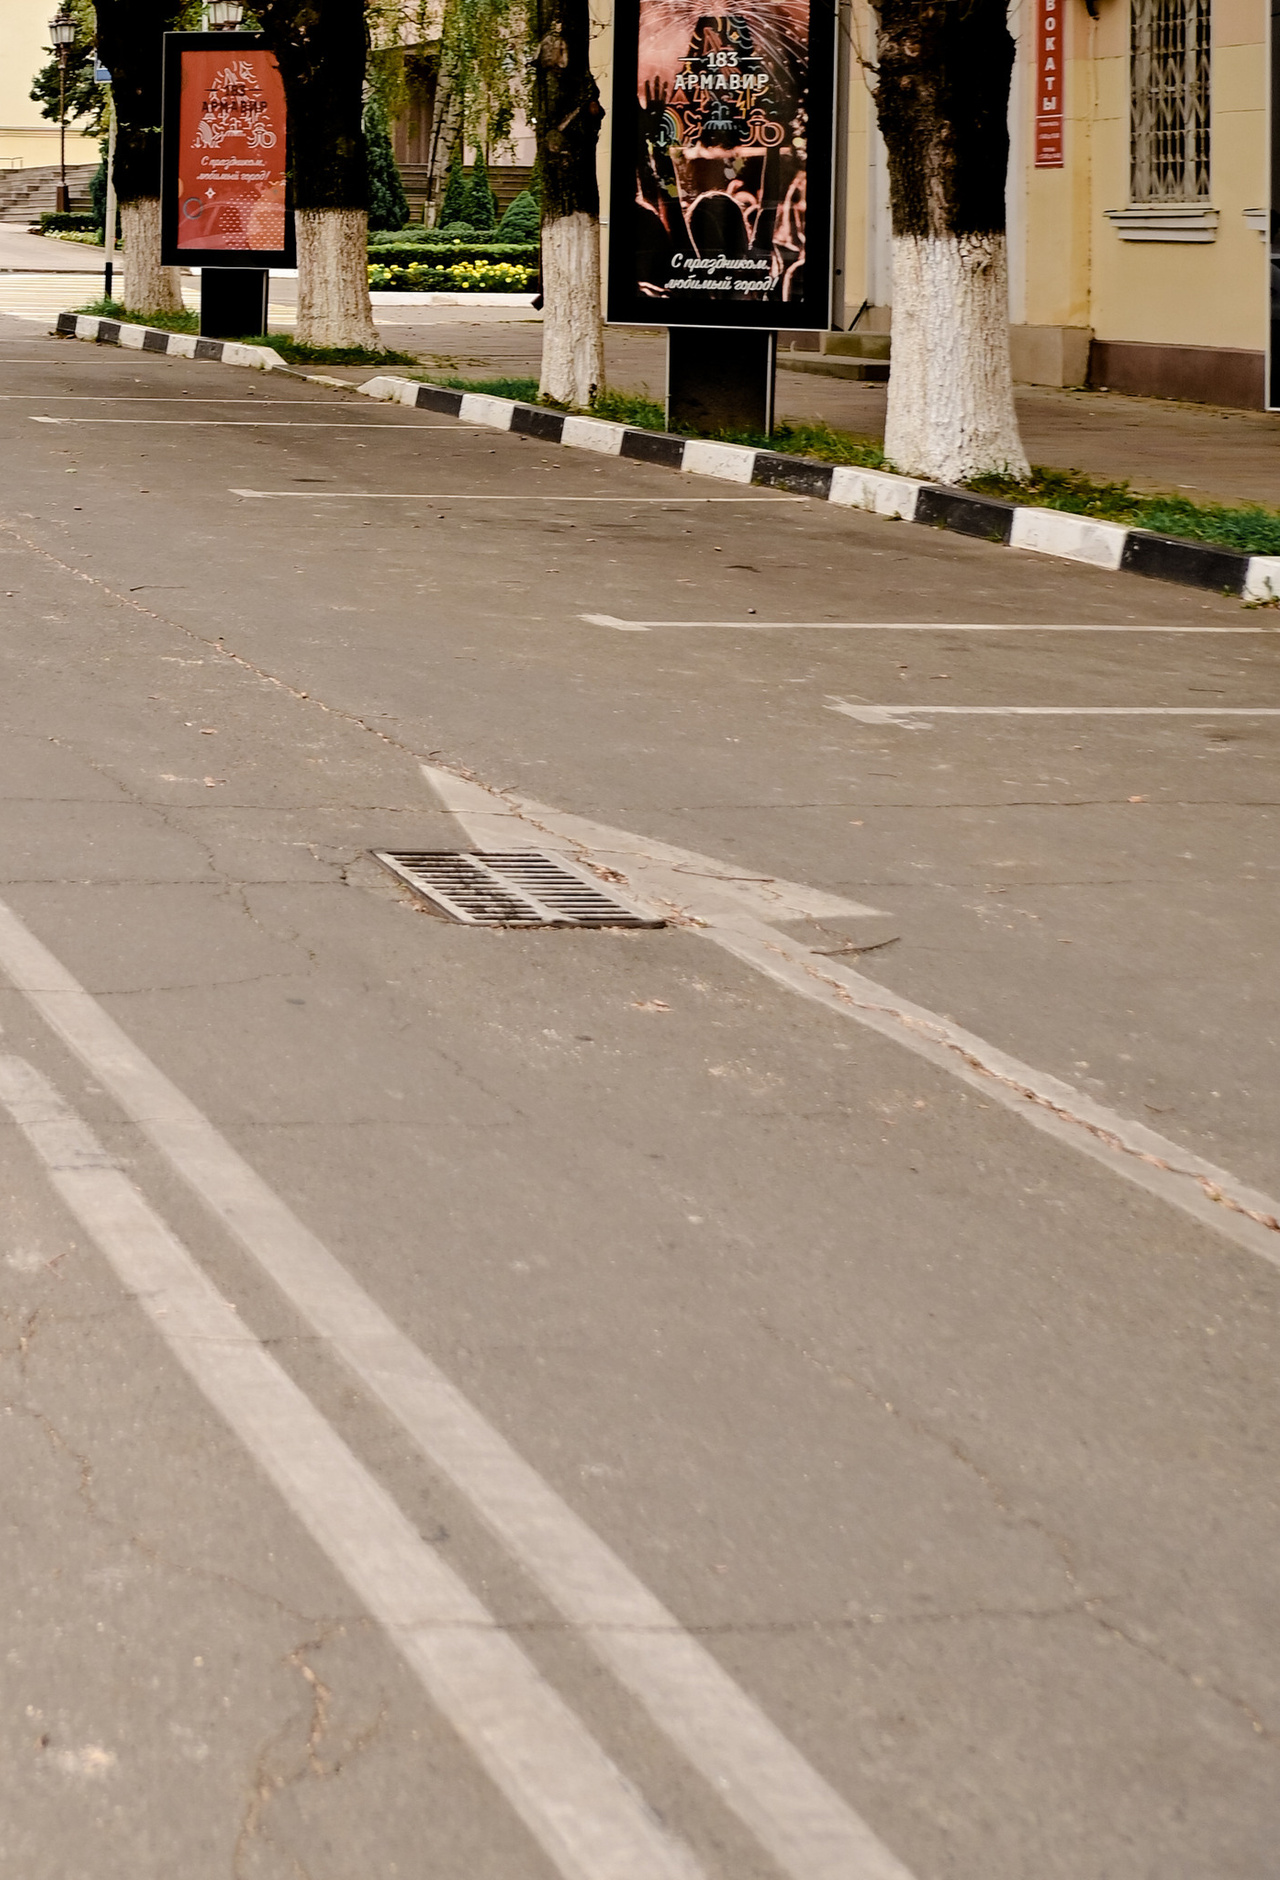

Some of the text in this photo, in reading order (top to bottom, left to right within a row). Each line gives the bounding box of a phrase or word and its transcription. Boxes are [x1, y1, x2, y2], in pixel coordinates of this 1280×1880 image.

[706, 51, 739, 68] 183
[673, 73, 770, 91] АРМАВИР
[201, 101, 268, 113] АРМАВИР
[200, 155, 210, 166] С
[670, 252, 684, 268] С
[663, 274, 780, 295] любимый город!
